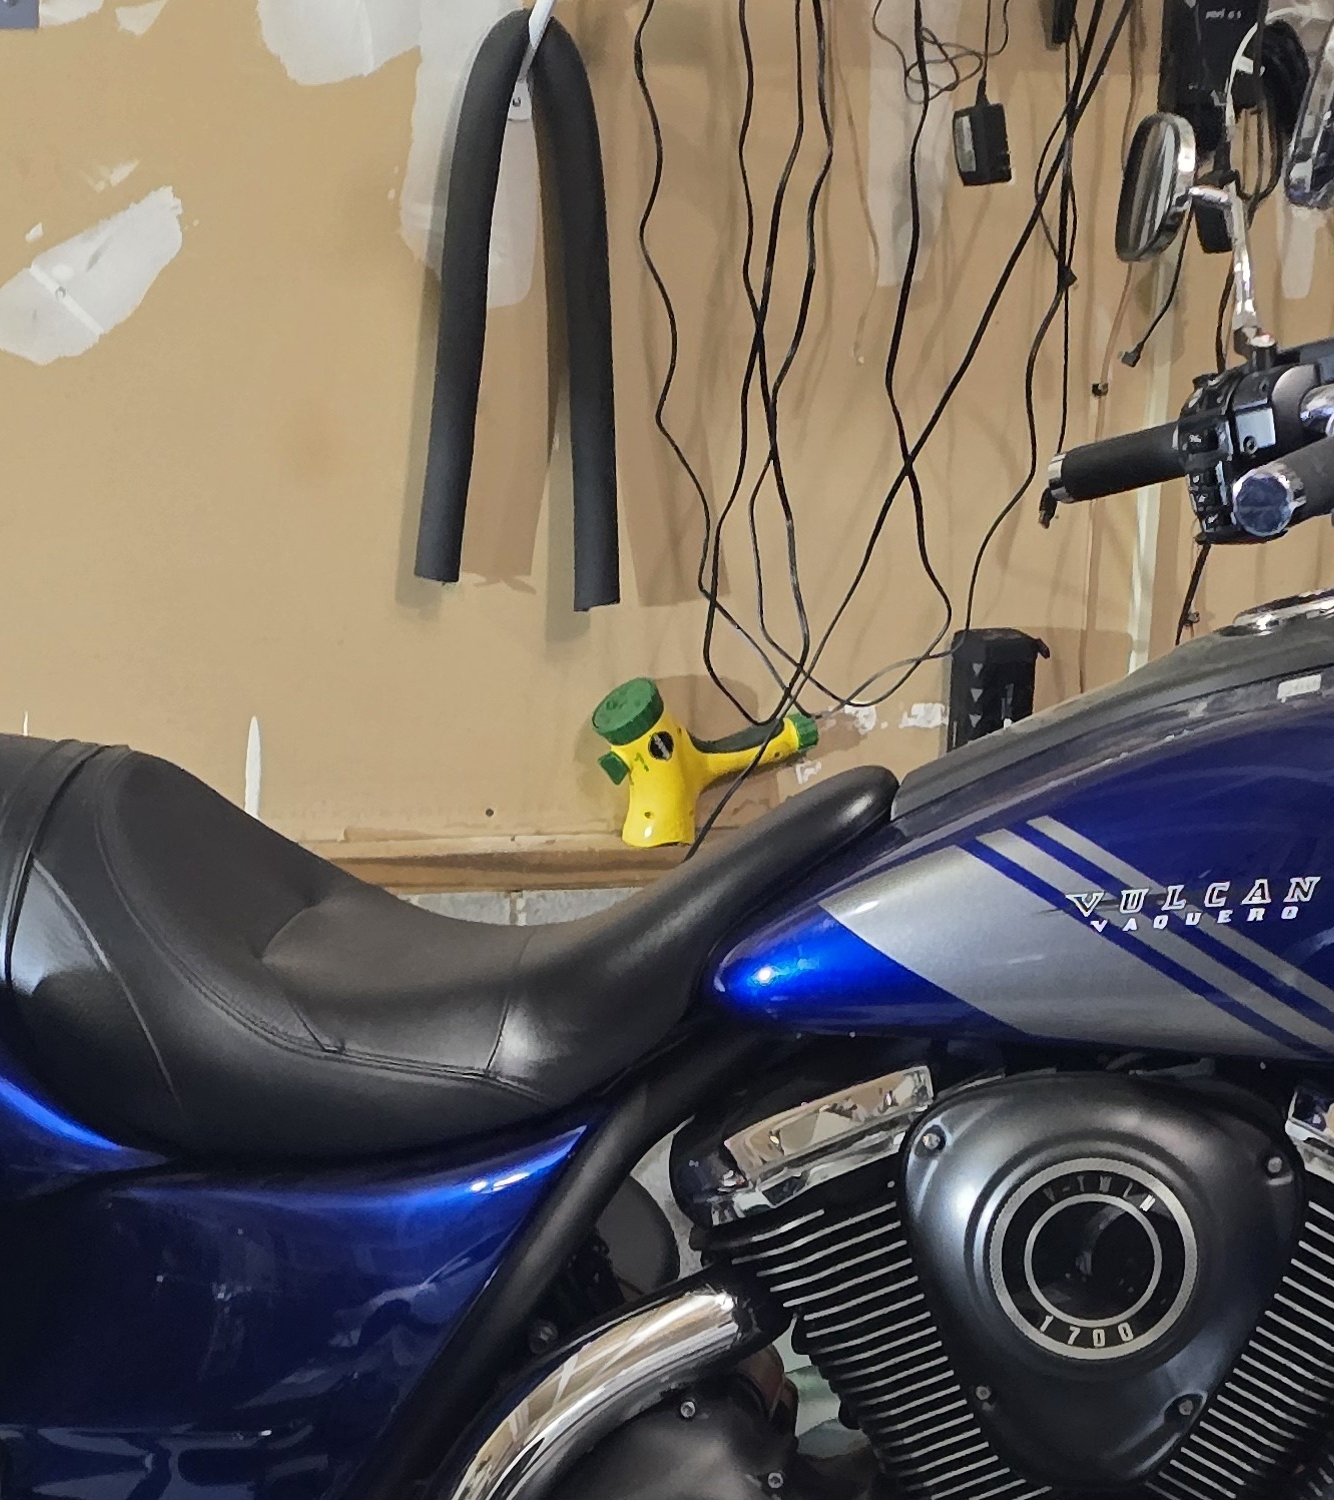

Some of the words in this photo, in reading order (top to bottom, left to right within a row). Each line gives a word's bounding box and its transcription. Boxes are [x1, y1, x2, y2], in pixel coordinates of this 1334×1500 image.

[1066, 876, 1321, 917] VULCAN
[1090, 906, 1299, 932] VAQUERO
[1040, 1315, 1134, 1348] 1700
